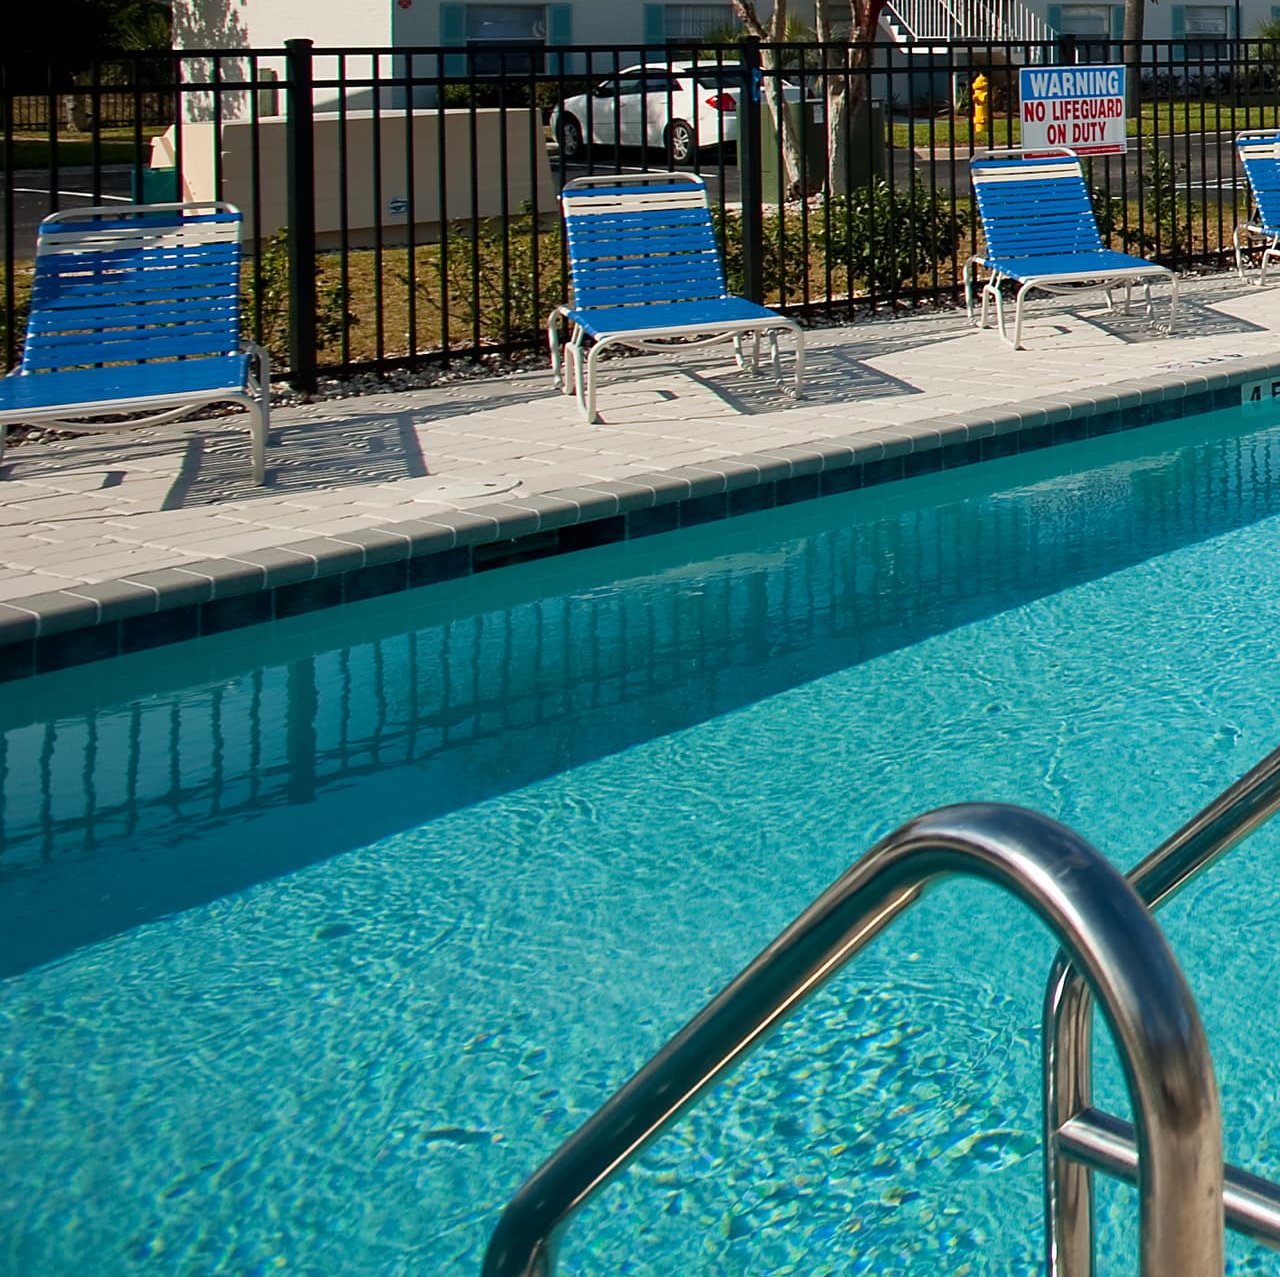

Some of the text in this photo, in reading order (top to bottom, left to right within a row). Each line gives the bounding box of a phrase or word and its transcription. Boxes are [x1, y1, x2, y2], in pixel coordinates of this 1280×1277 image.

[1030, 71, 1119, 97] WARNING
[1023, 98, 1123, 123] NO LIFEGUARD
[1047, 121, 1107, 145] ON DUTY
